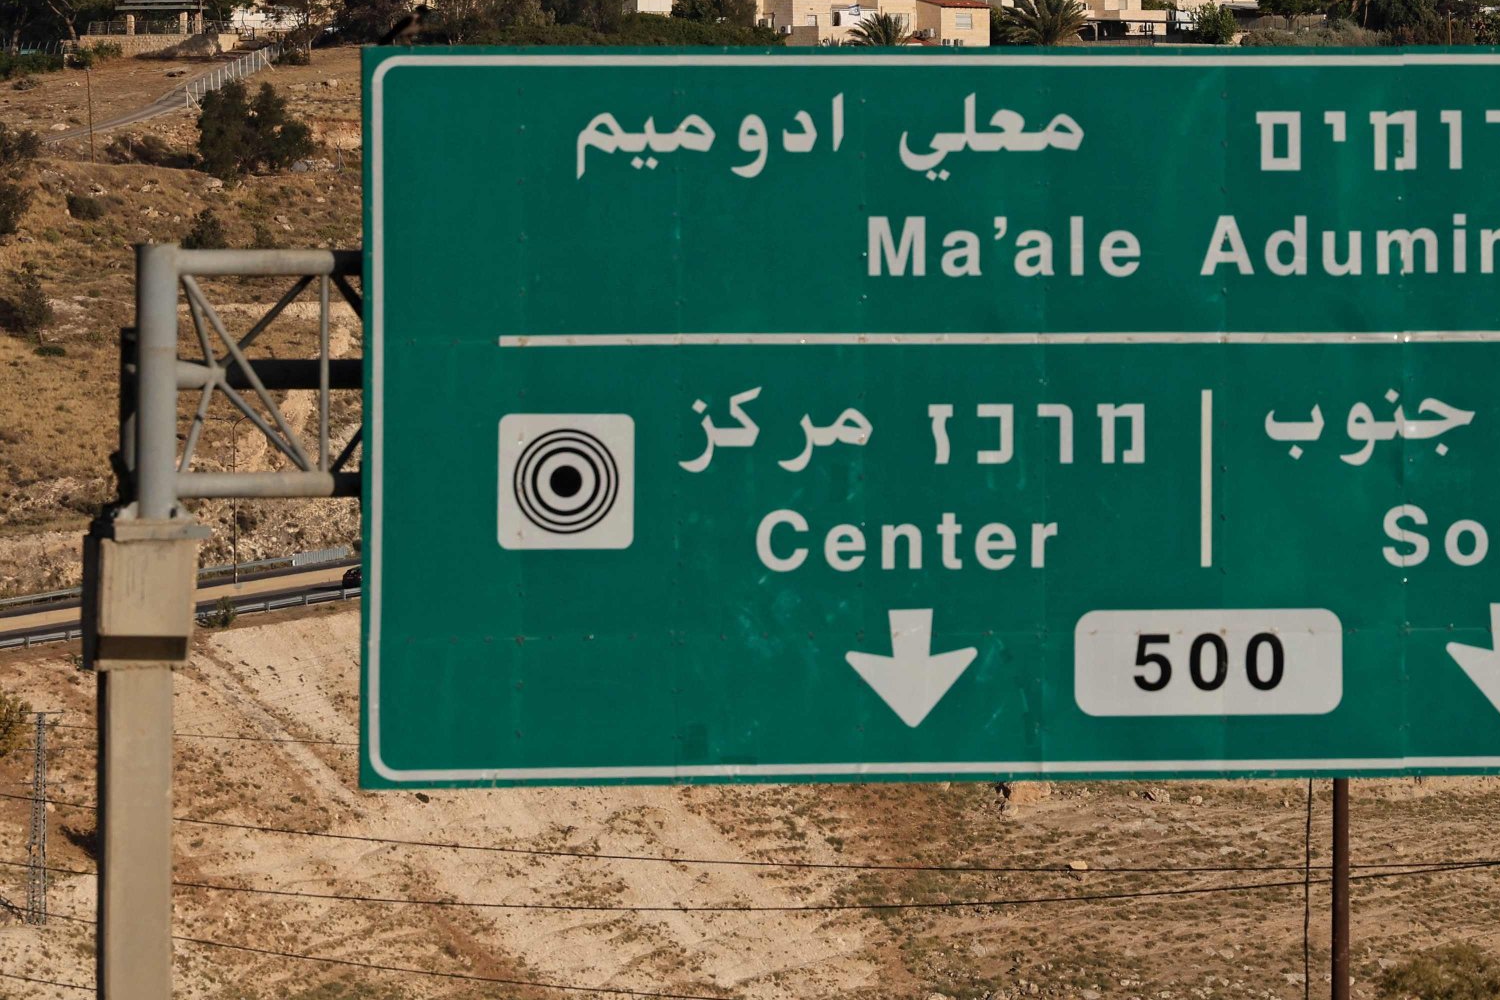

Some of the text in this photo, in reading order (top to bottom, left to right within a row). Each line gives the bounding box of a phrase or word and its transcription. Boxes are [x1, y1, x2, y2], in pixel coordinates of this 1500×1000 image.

[576, 92, 1085, 181] معلي ادوميم
[678, 386, 873, 473] مركز
[927, 403, 1146, 465] מרכז
[1263, 388, 1476, 467] جنوب
[755, 508, 1058, 573] Center
[1132, 632, 1286, 693] 500
